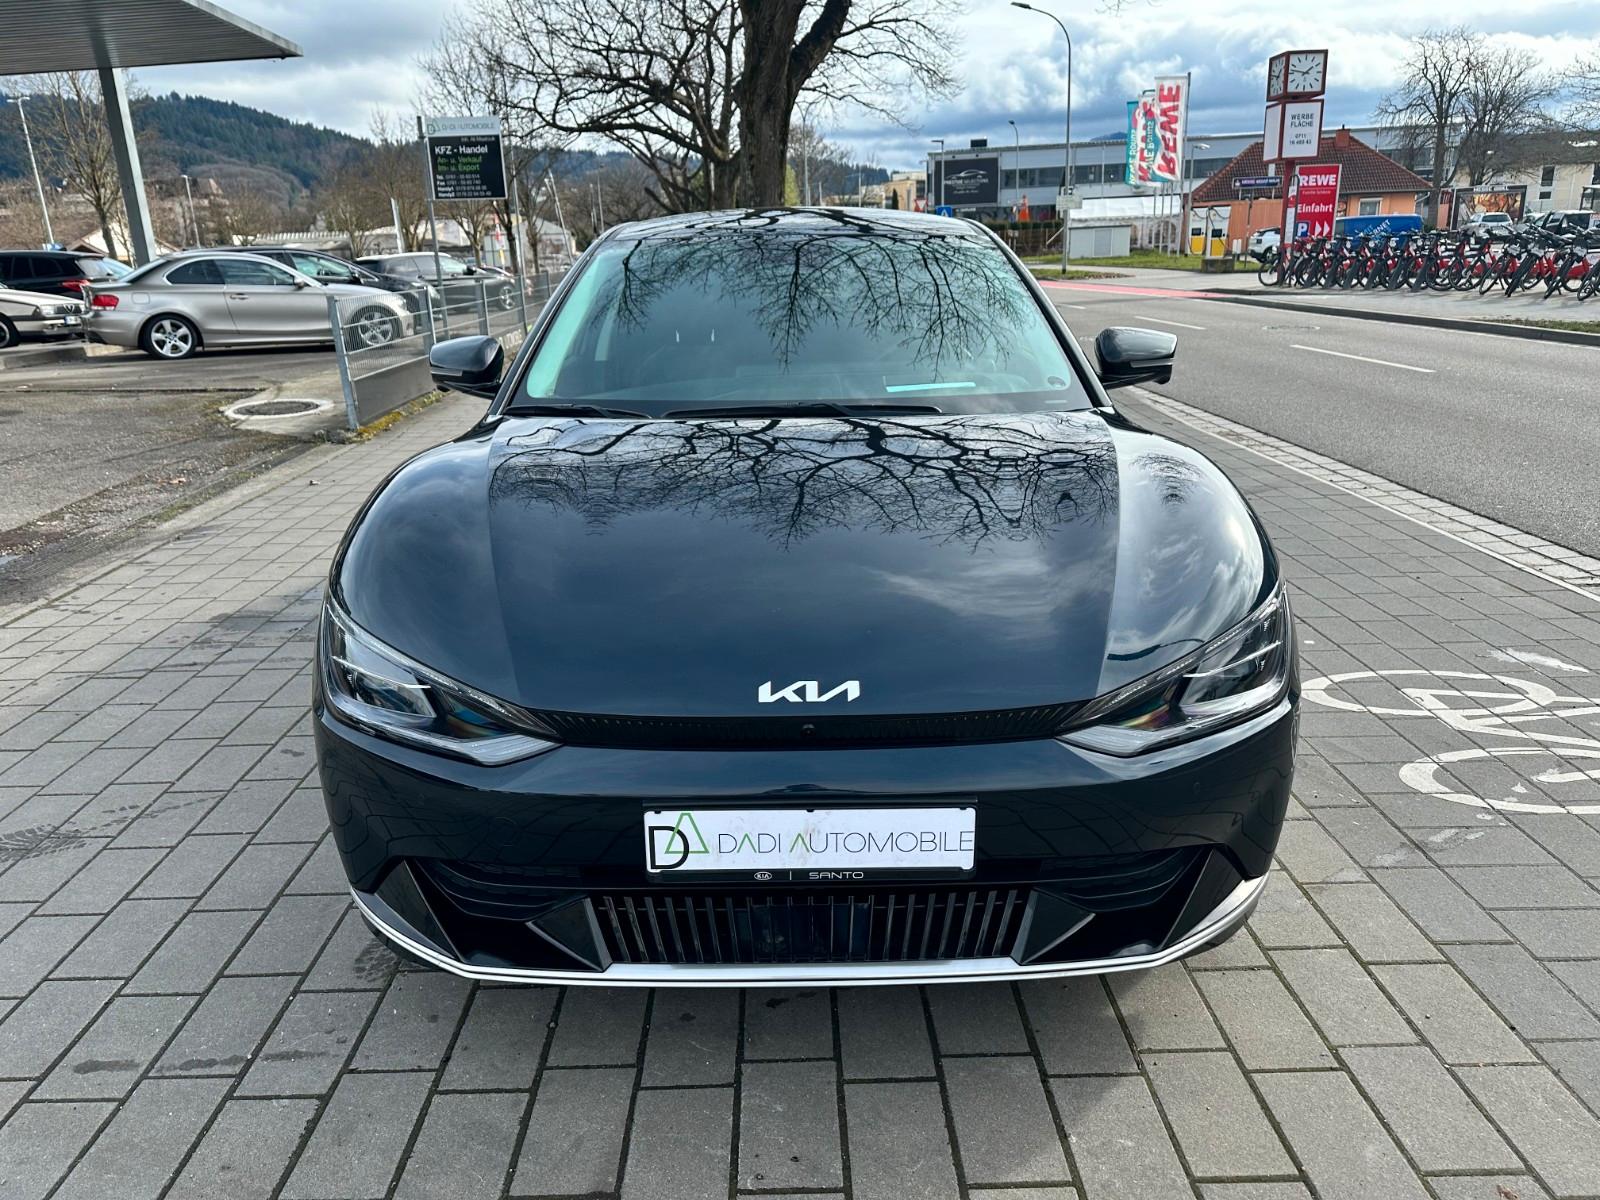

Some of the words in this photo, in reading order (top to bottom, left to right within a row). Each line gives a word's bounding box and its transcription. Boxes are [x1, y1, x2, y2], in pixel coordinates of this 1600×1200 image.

[434, 145, 452, 154] KFZ
[459, 144, 488, 153] Handel
[458, 163, 480, 172] Export
[1299, 174, 1337, 186] REWE
[1297, 202, 1332, 213] Einfahrt
[757, 680, 861, 703] KIA
[718, 833, 781, 854] DADI
[789, 831, 975, 853] AUTOMOBILE
[808, 871, 864, 880] SANTO
